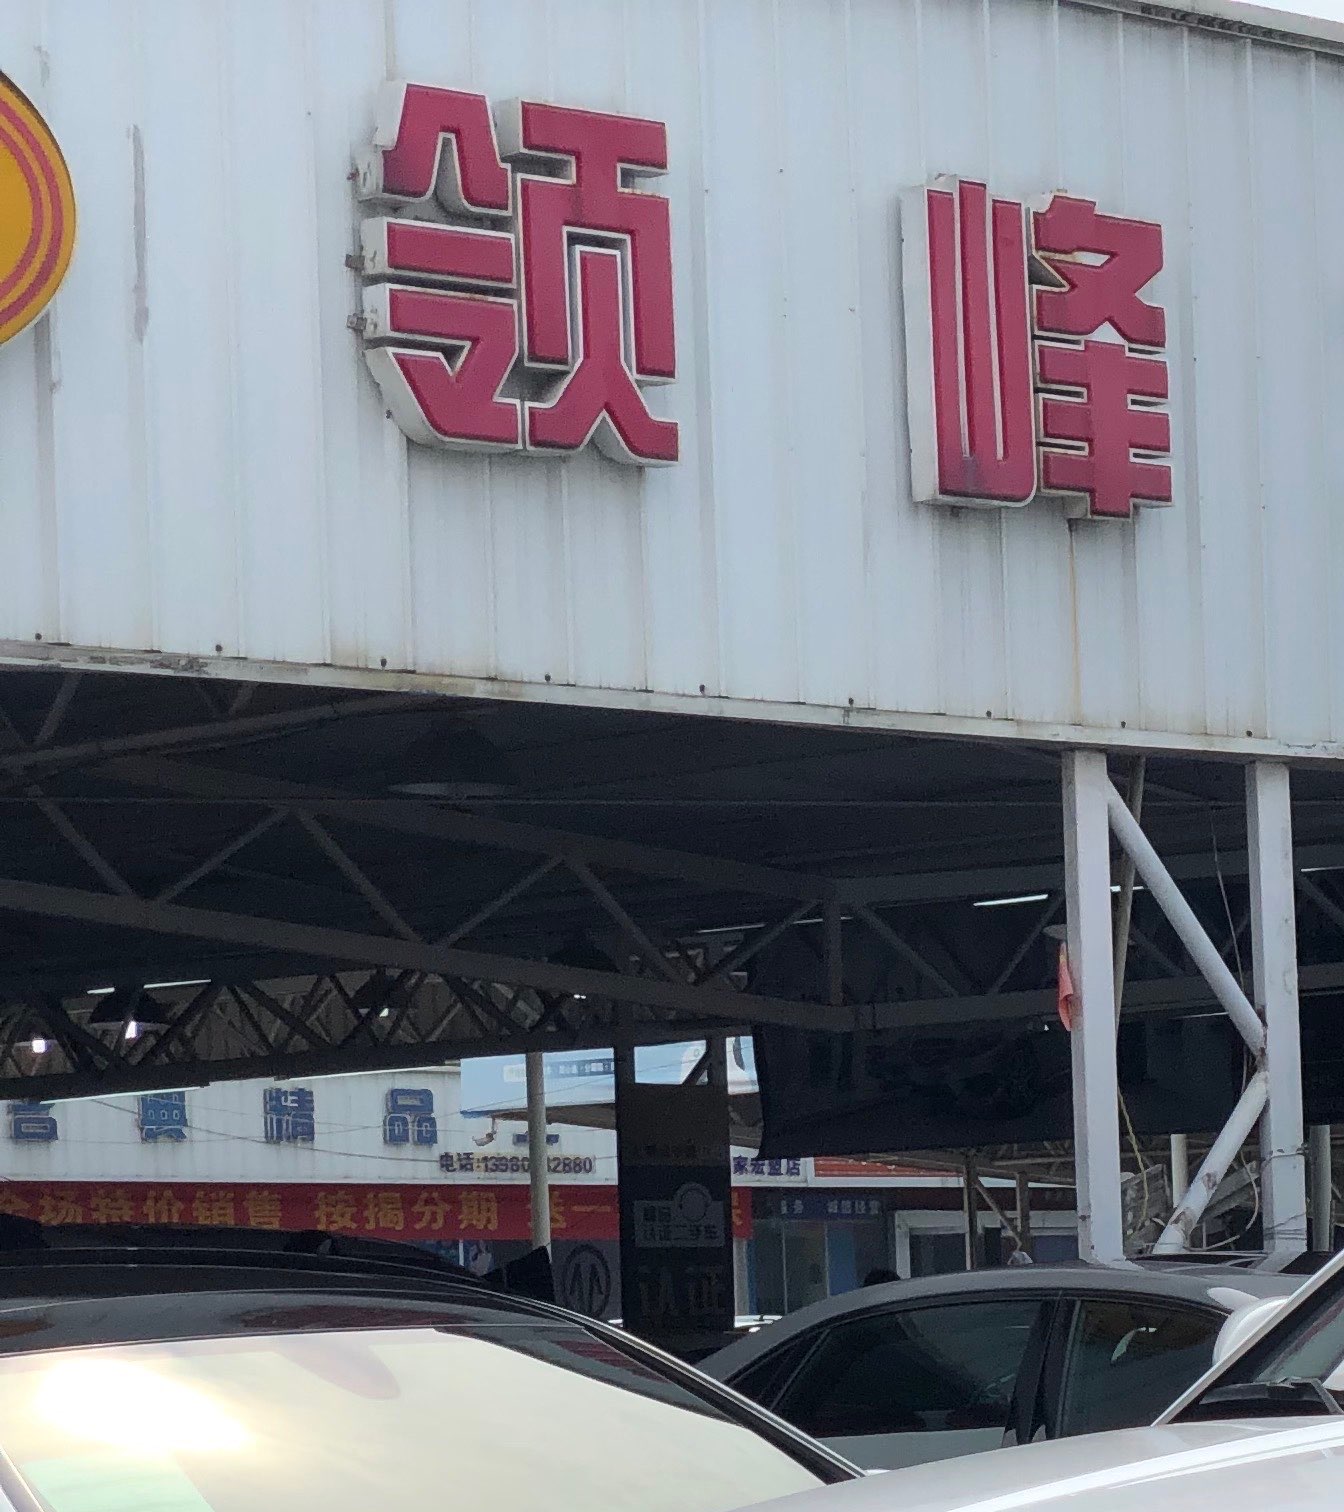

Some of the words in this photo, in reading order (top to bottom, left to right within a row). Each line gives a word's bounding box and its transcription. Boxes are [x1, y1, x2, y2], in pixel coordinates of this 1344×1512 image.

[439, 1151, 594, 1174] 电话:139802880
[314, 1190, 499, 1231] 按揭分期
